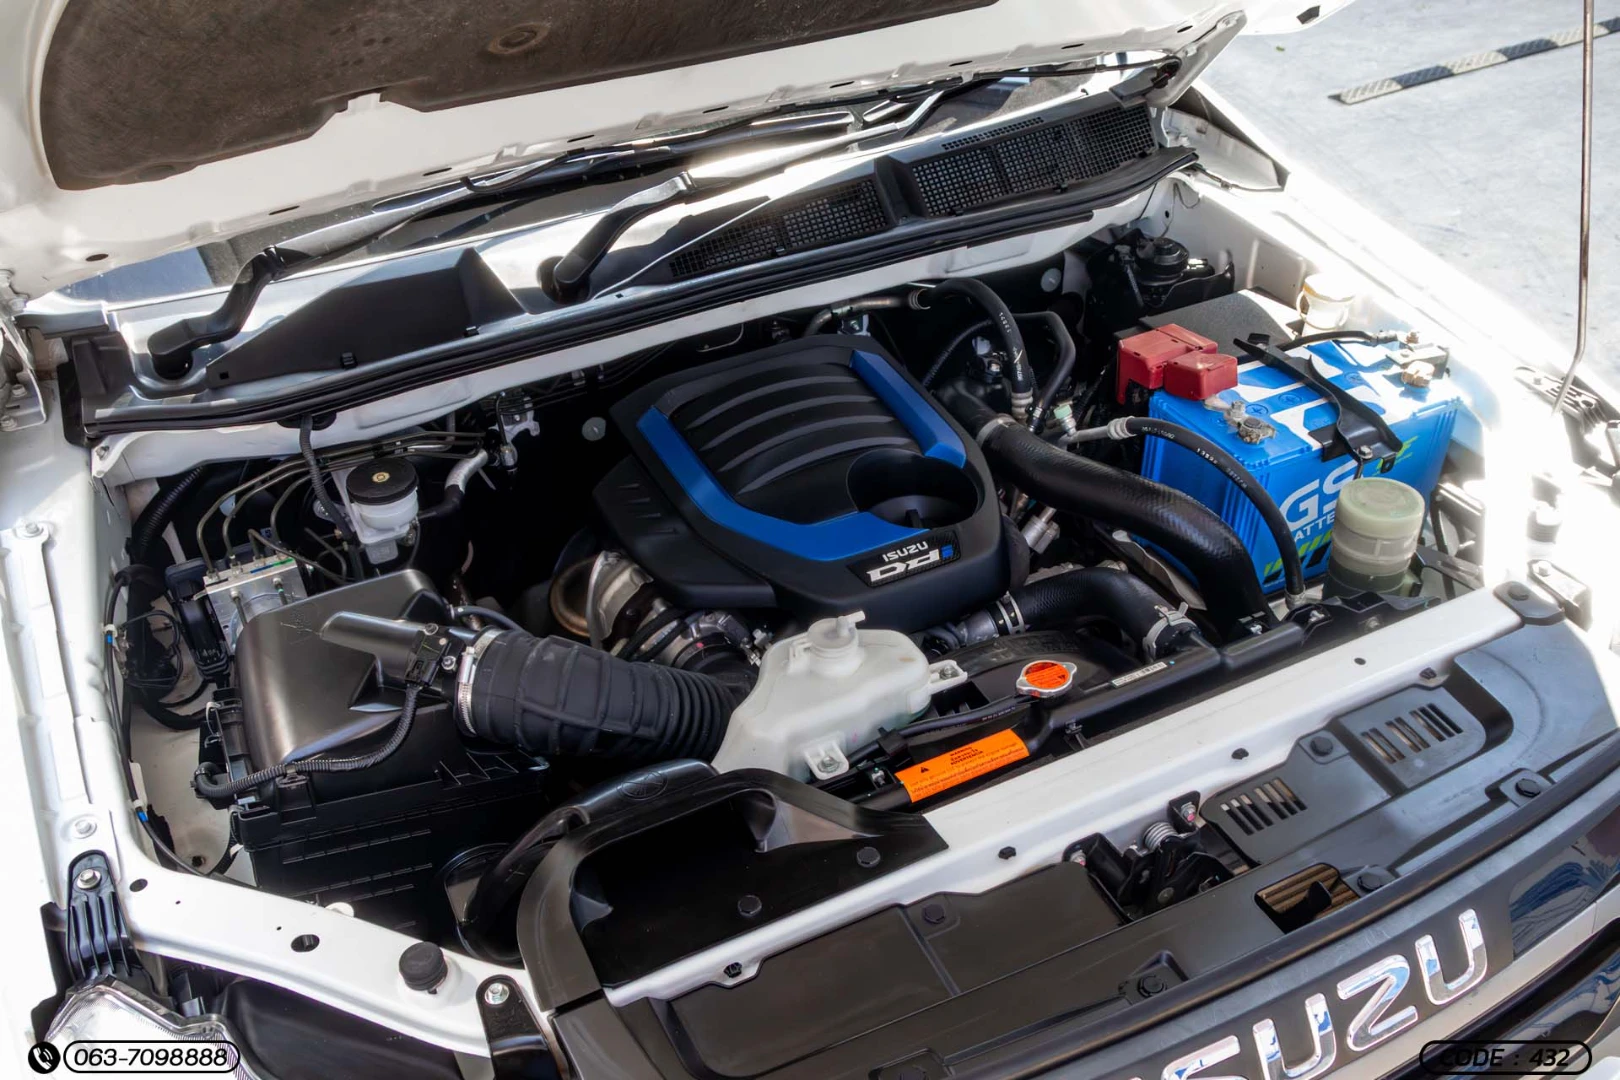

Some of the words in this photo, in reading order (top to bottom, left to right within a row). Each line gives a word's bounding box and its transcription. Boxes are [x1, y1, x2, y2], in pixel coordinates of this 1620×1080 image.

[1294, 512, 1336, 543] ATTE
[882, 541, 929, 562] ISUZU
[1128, 909, 1488, 1080] UZU
